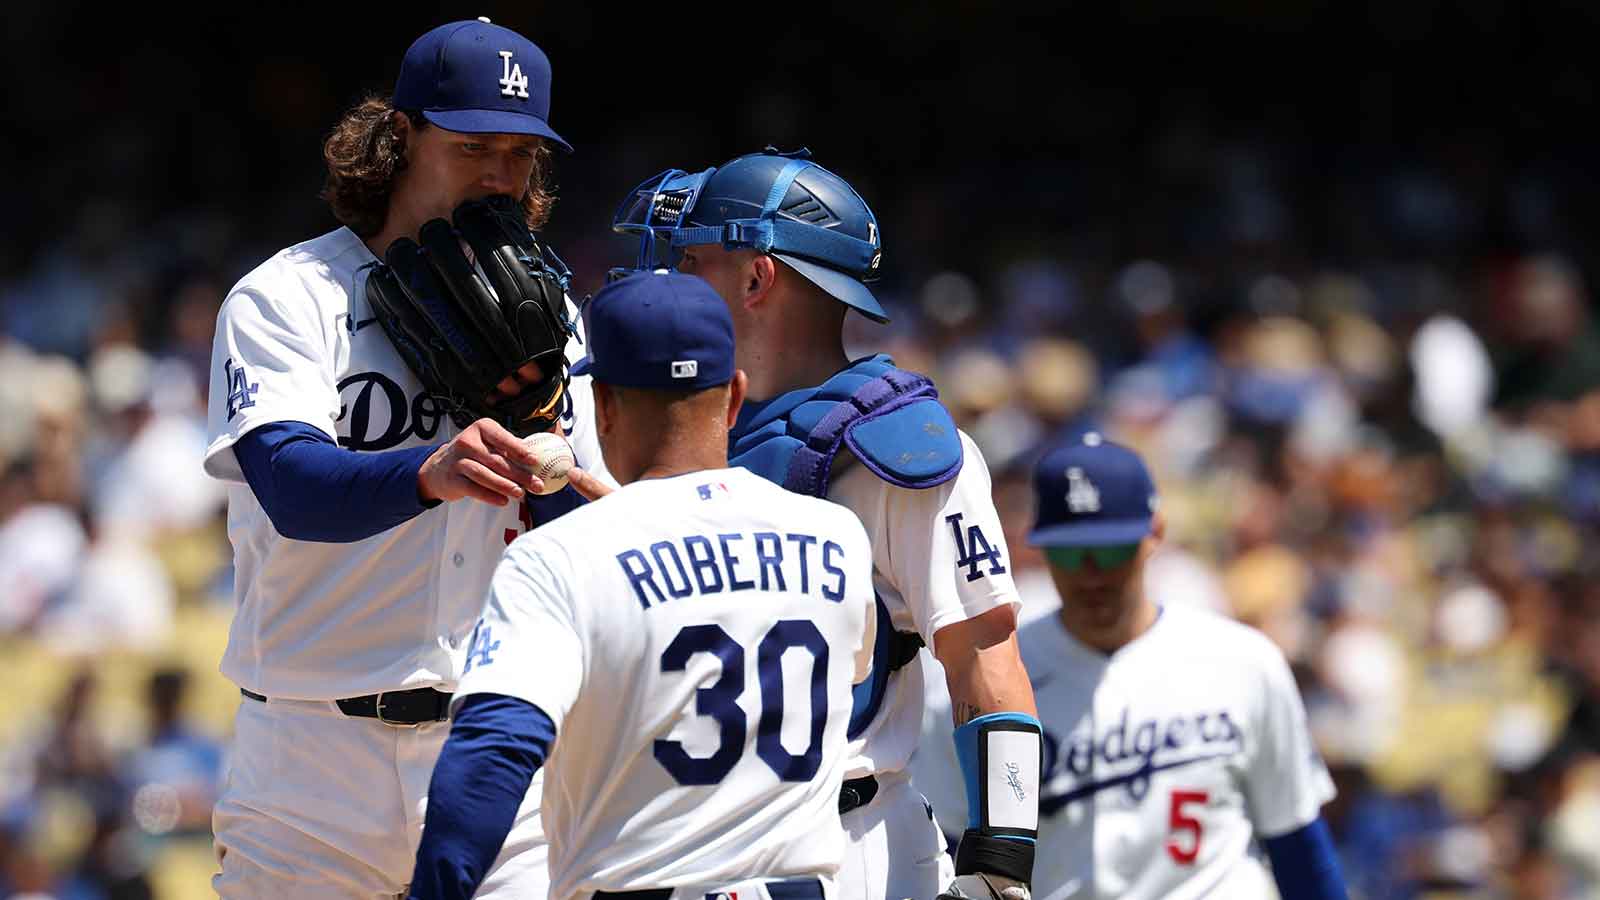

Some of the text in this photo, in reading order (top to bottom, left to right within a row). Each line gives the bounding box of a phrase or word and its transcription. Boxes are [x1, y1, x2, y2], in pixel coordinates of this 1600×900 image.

[499, 51, 529, 98] LA
[225, 358, 259, 423] LA
[616, 532, 846, 610] ROBERTS
[945, 512, 1006, 582] LA
[464, 618, 501, 674] LA
[653, 619, 830, 786] 30
[1167, 790, 1209, 866] 5
